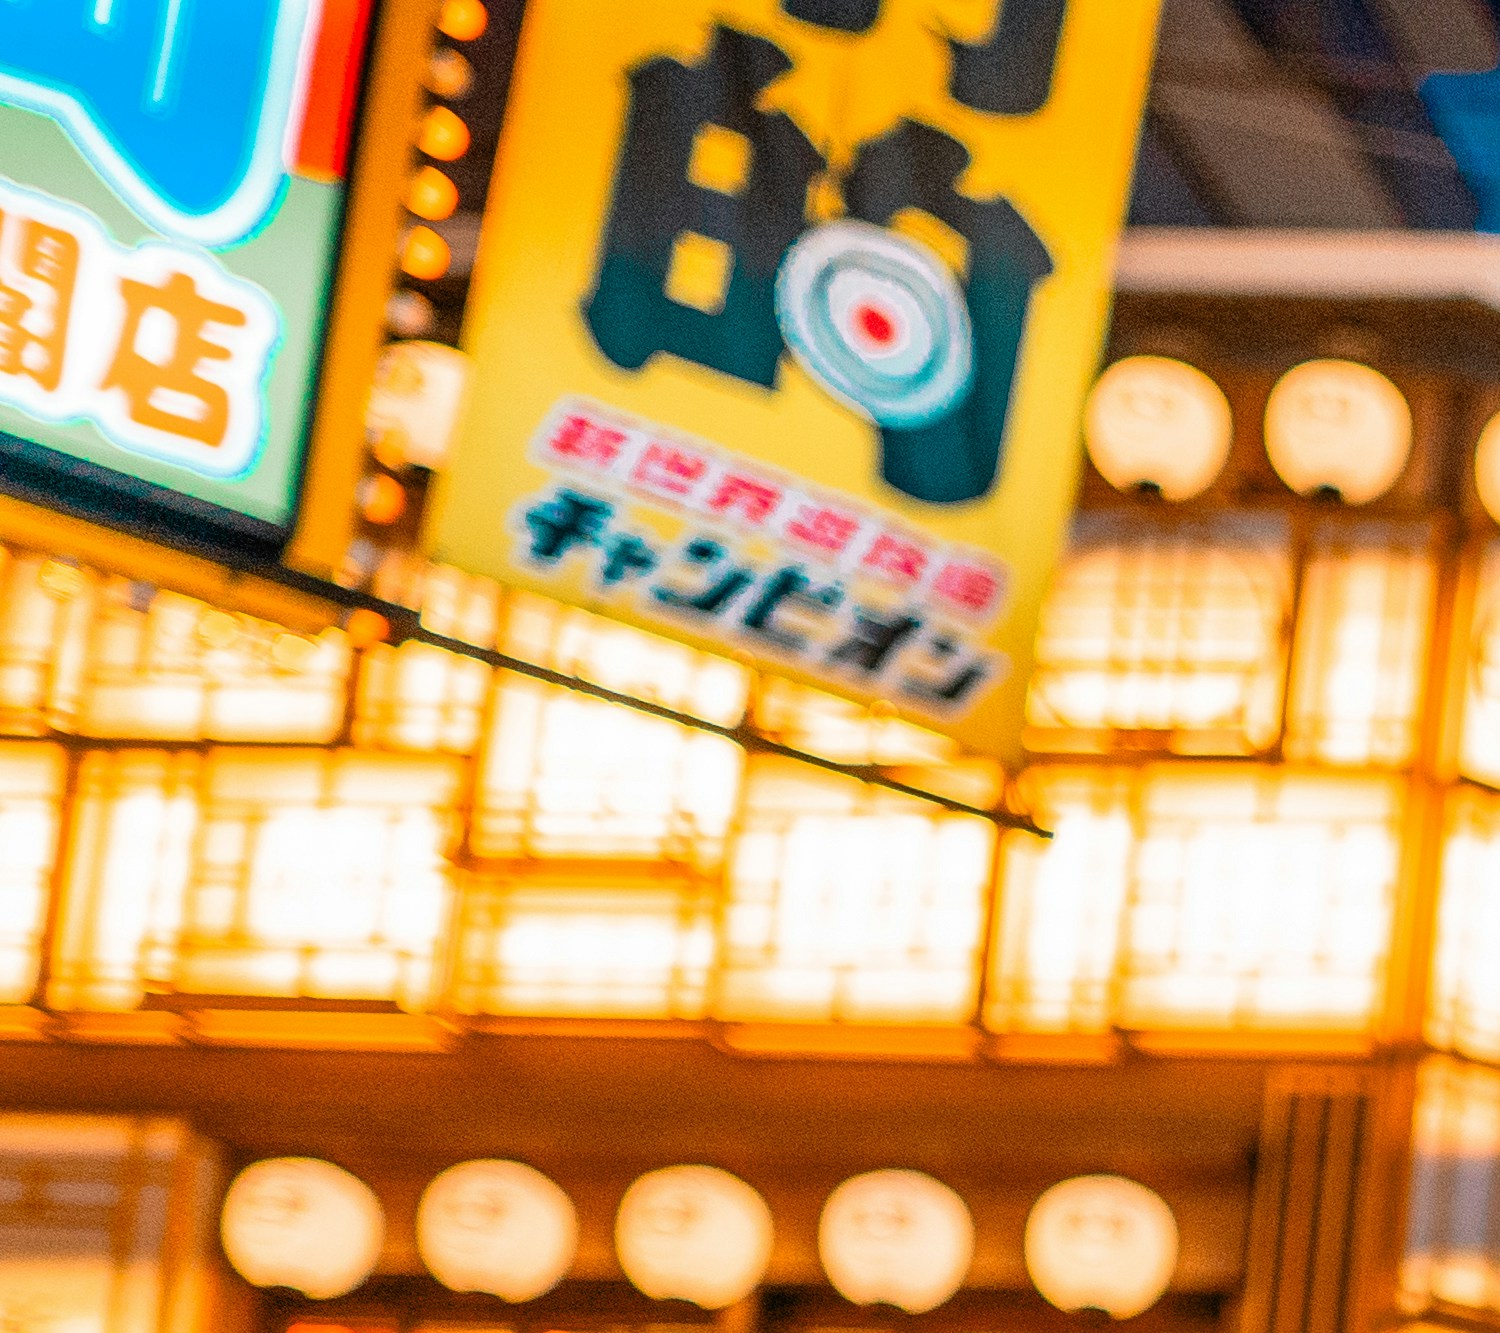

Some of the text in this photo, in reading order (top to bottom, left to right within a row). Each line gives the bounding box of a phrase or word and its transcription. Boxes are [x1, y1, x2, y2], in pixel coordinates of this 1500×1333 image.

[524, 487, 985, 700] チャンピオン
